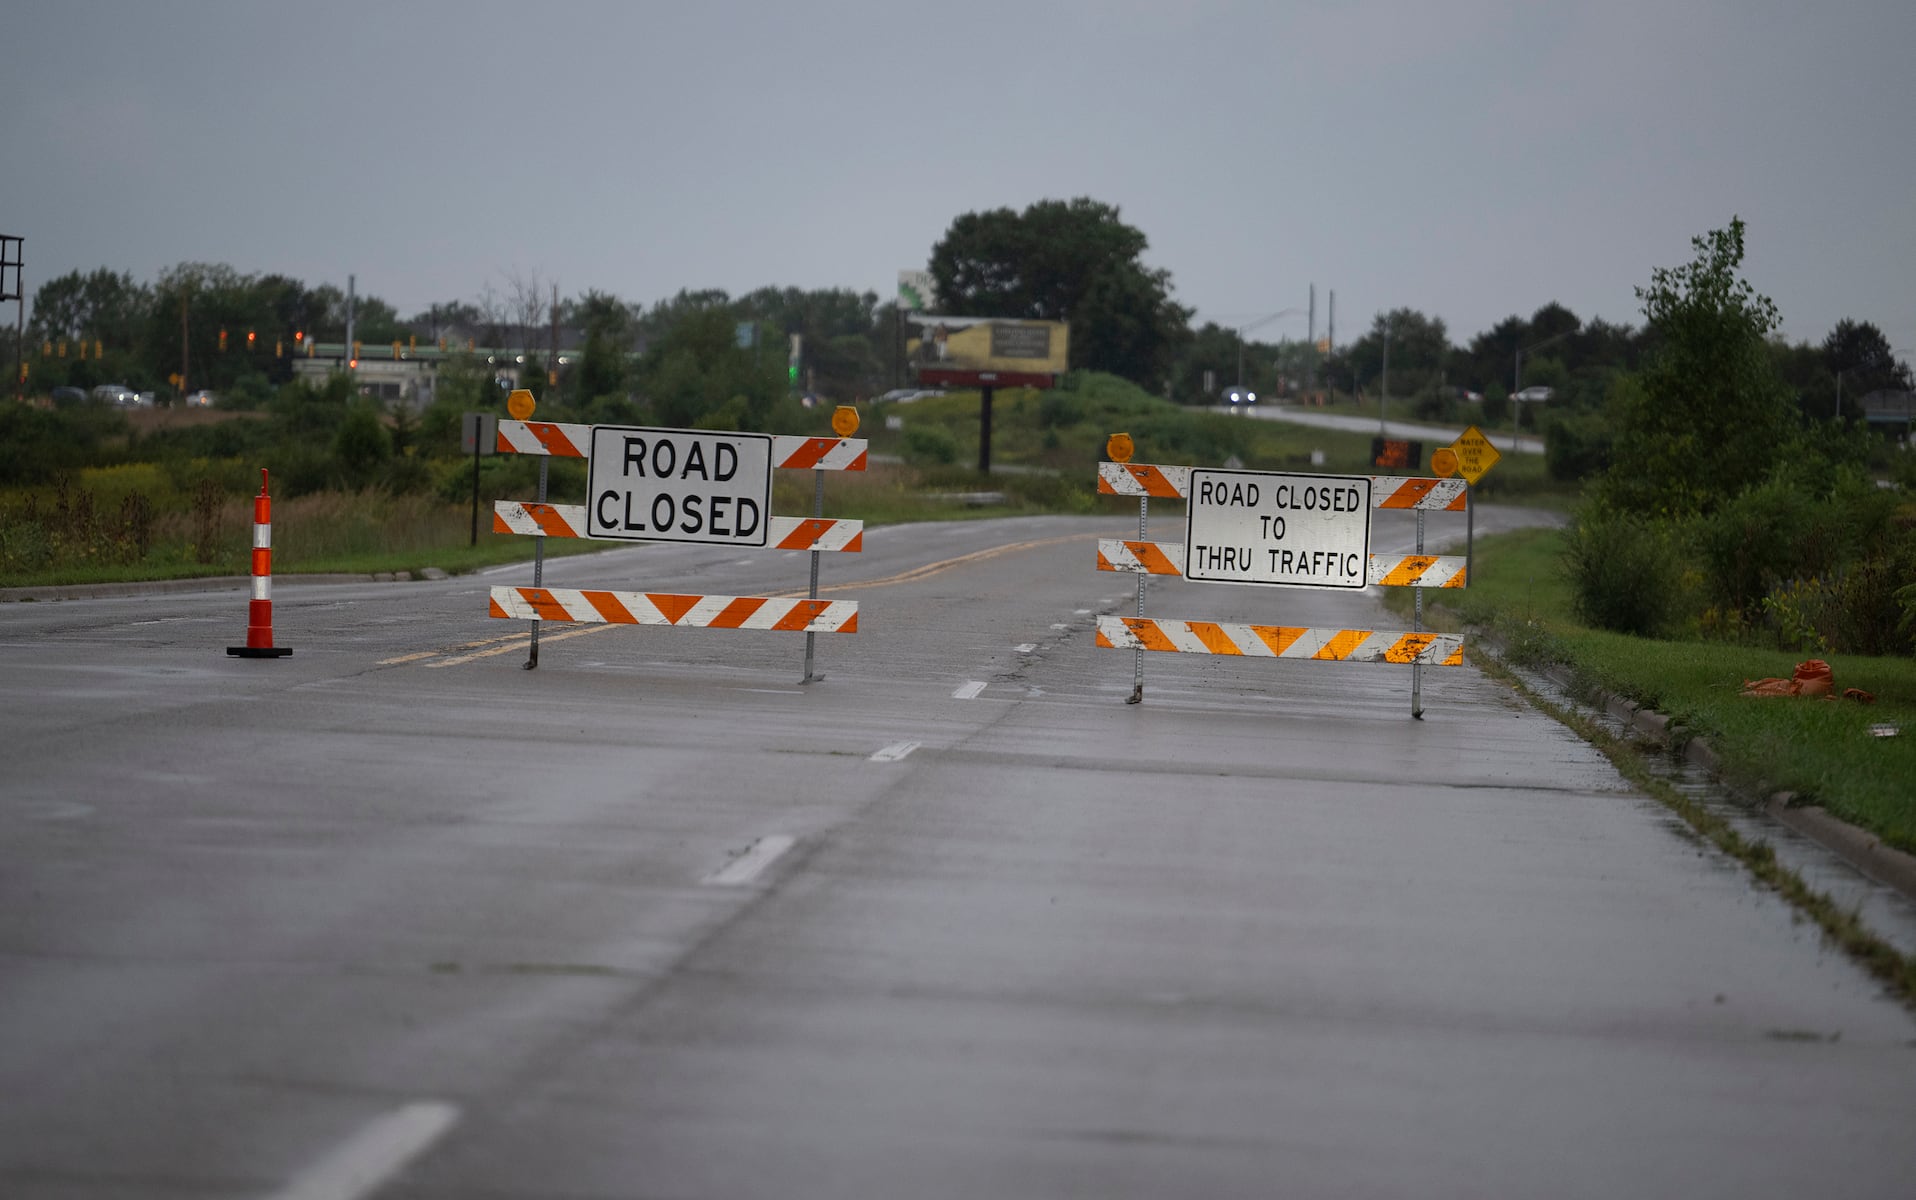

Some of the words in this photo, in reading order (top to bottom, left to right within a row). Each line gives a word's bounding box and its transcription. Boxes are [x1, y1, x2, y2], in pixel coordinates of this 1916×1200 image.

[623, 437, 738, 482] ROAD
[1462, 447, 1482, 455] OVER
[1465, 456, 1479, 464] THE
[1461, 465, 1482, 473] ROAD
[1200, 481, 1259, 507] ROAD
[1276, 485, 1360, 512] CLOSED
[597, 490, 759, 537] CLOSED
[1260, 515, 1286, 540] TO
[1196, 545, 1252, 572] THRU
[1268, 549, 1359, 577] TRAFFIC
